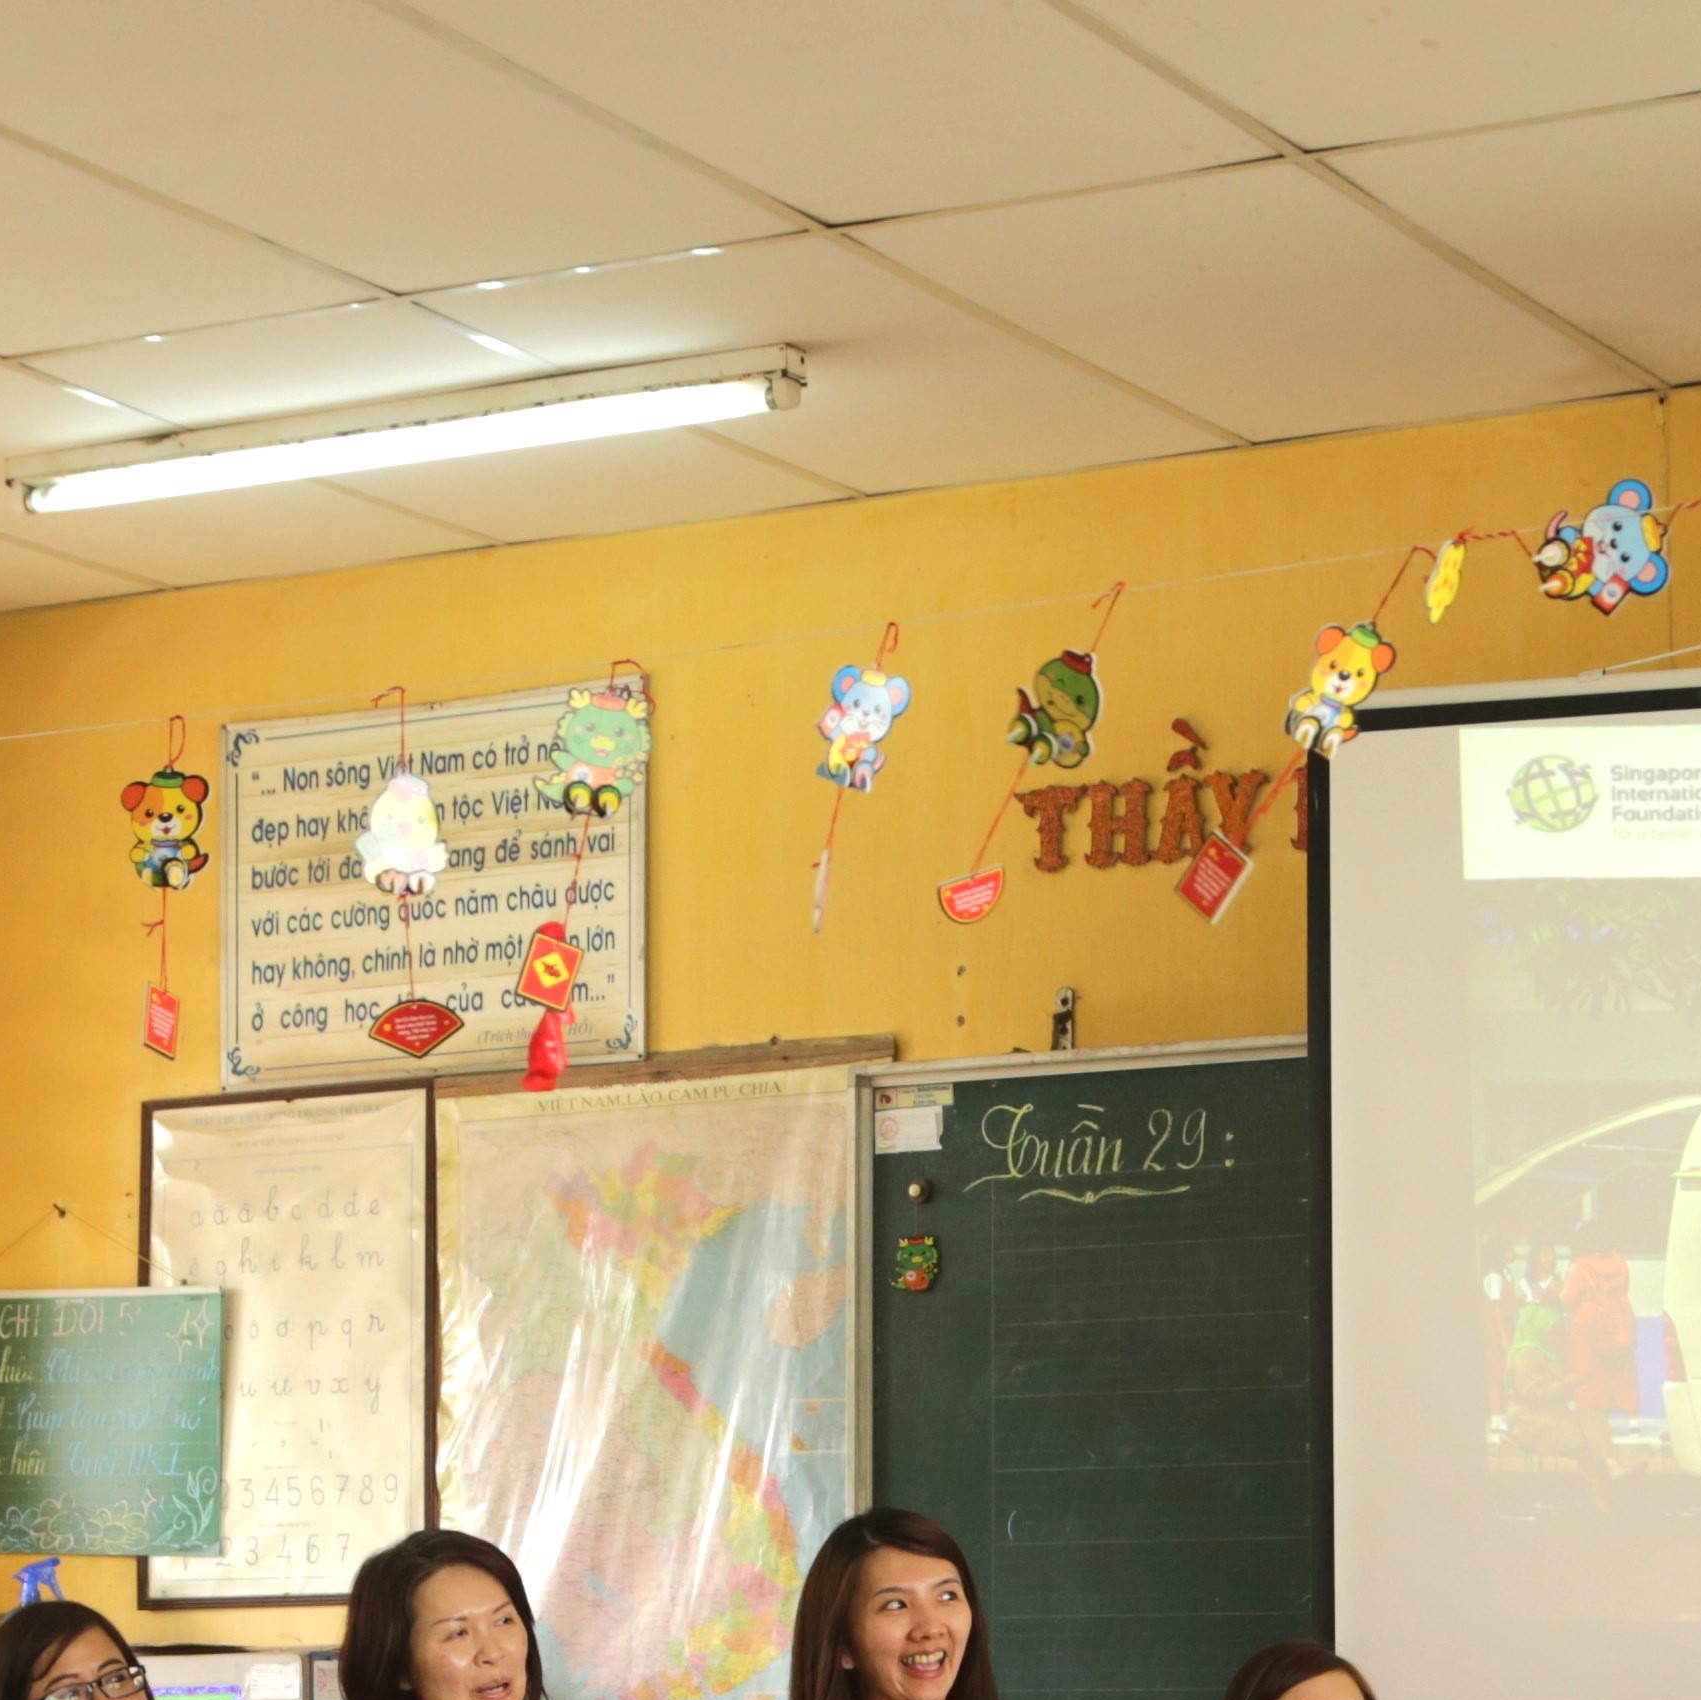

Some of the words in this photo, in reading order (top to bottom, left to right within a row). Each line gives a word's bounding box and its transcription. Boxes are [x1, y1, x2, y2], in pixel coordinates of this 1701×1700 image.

[283, 766, 320, 792] Non
[324, 760, 371, 790] sông
[421, 748, 465, 774] Nam
[472, 744, 497, 769] có
[504, 735, 530, 766] trở
[1013, 717, 1270, 873] THẦY
[251, 814, 290, 846] đẹp
[297, 811, 331, 839] hay
[336, 806, 369, 834] khô
[452, 797, 484, 826] tộc
[492, 788, 530, 819] Việt
[251, 862, 300, 890] bước
[308, 857, 330, 884] tới
[495, 829, 521, 863] để
[531, 832, 579, 861] sánh
[588, 831, 616, 853] vai
[251, 912, 280, 939] với
[287, 906, 323, 933] các
[331, 902, 391, 931] cường
[398, 890, 447, 929] quốc
[454, 890, 500, 917] năm
[506, 885, 557, 912] châu
[564, 879, 616, 910] được
[251, 960, 287, 988] hay
[291, 950, 356, 982] không,
[361, 943, 414, 974] chính
[419, 941, 436, 968] là
[442, 940, 479, 967] nhờ
[485, 936, 523, 965] một
[586, 924, 616, 952] lớn
[251, 1001, 265, 1032] ở
[280, 1002, 329, 1032] công
[344, 995, 381, 1028] học
[445, 982, 484, 1013] của
[668, 1084, 708, 1102] CAM
[713, 1083, 734, 1099] PU
[738, 1080, 783, 1096] CHIA
[368, 1199, 382, 1217] e
[238, 1235, 259, 1274] h
[297, 1233, 320, 1272] k
[355, 1248, 384, 1268] m
[0, 1303, 42, 1340] CHI
[307, 1319, 328, 1351] p
[364, 1375, 382, 1416] y
[239, 1477, 255, 1509] 3
[264, 1476, 280, 1507] 4
[286, 1475, 303, 1507] 5
[309, 1475, 326, 1506] 6
[334, 1474, 351, 1505] 7
[358, 1473, 375, 1505] 8
[383, 1472, 399, 1504] 9
[244, 1535, 261, 1567] 3
[275, 1533, 293, 1566] 4
[336, 1532, 351, 1563] 7
